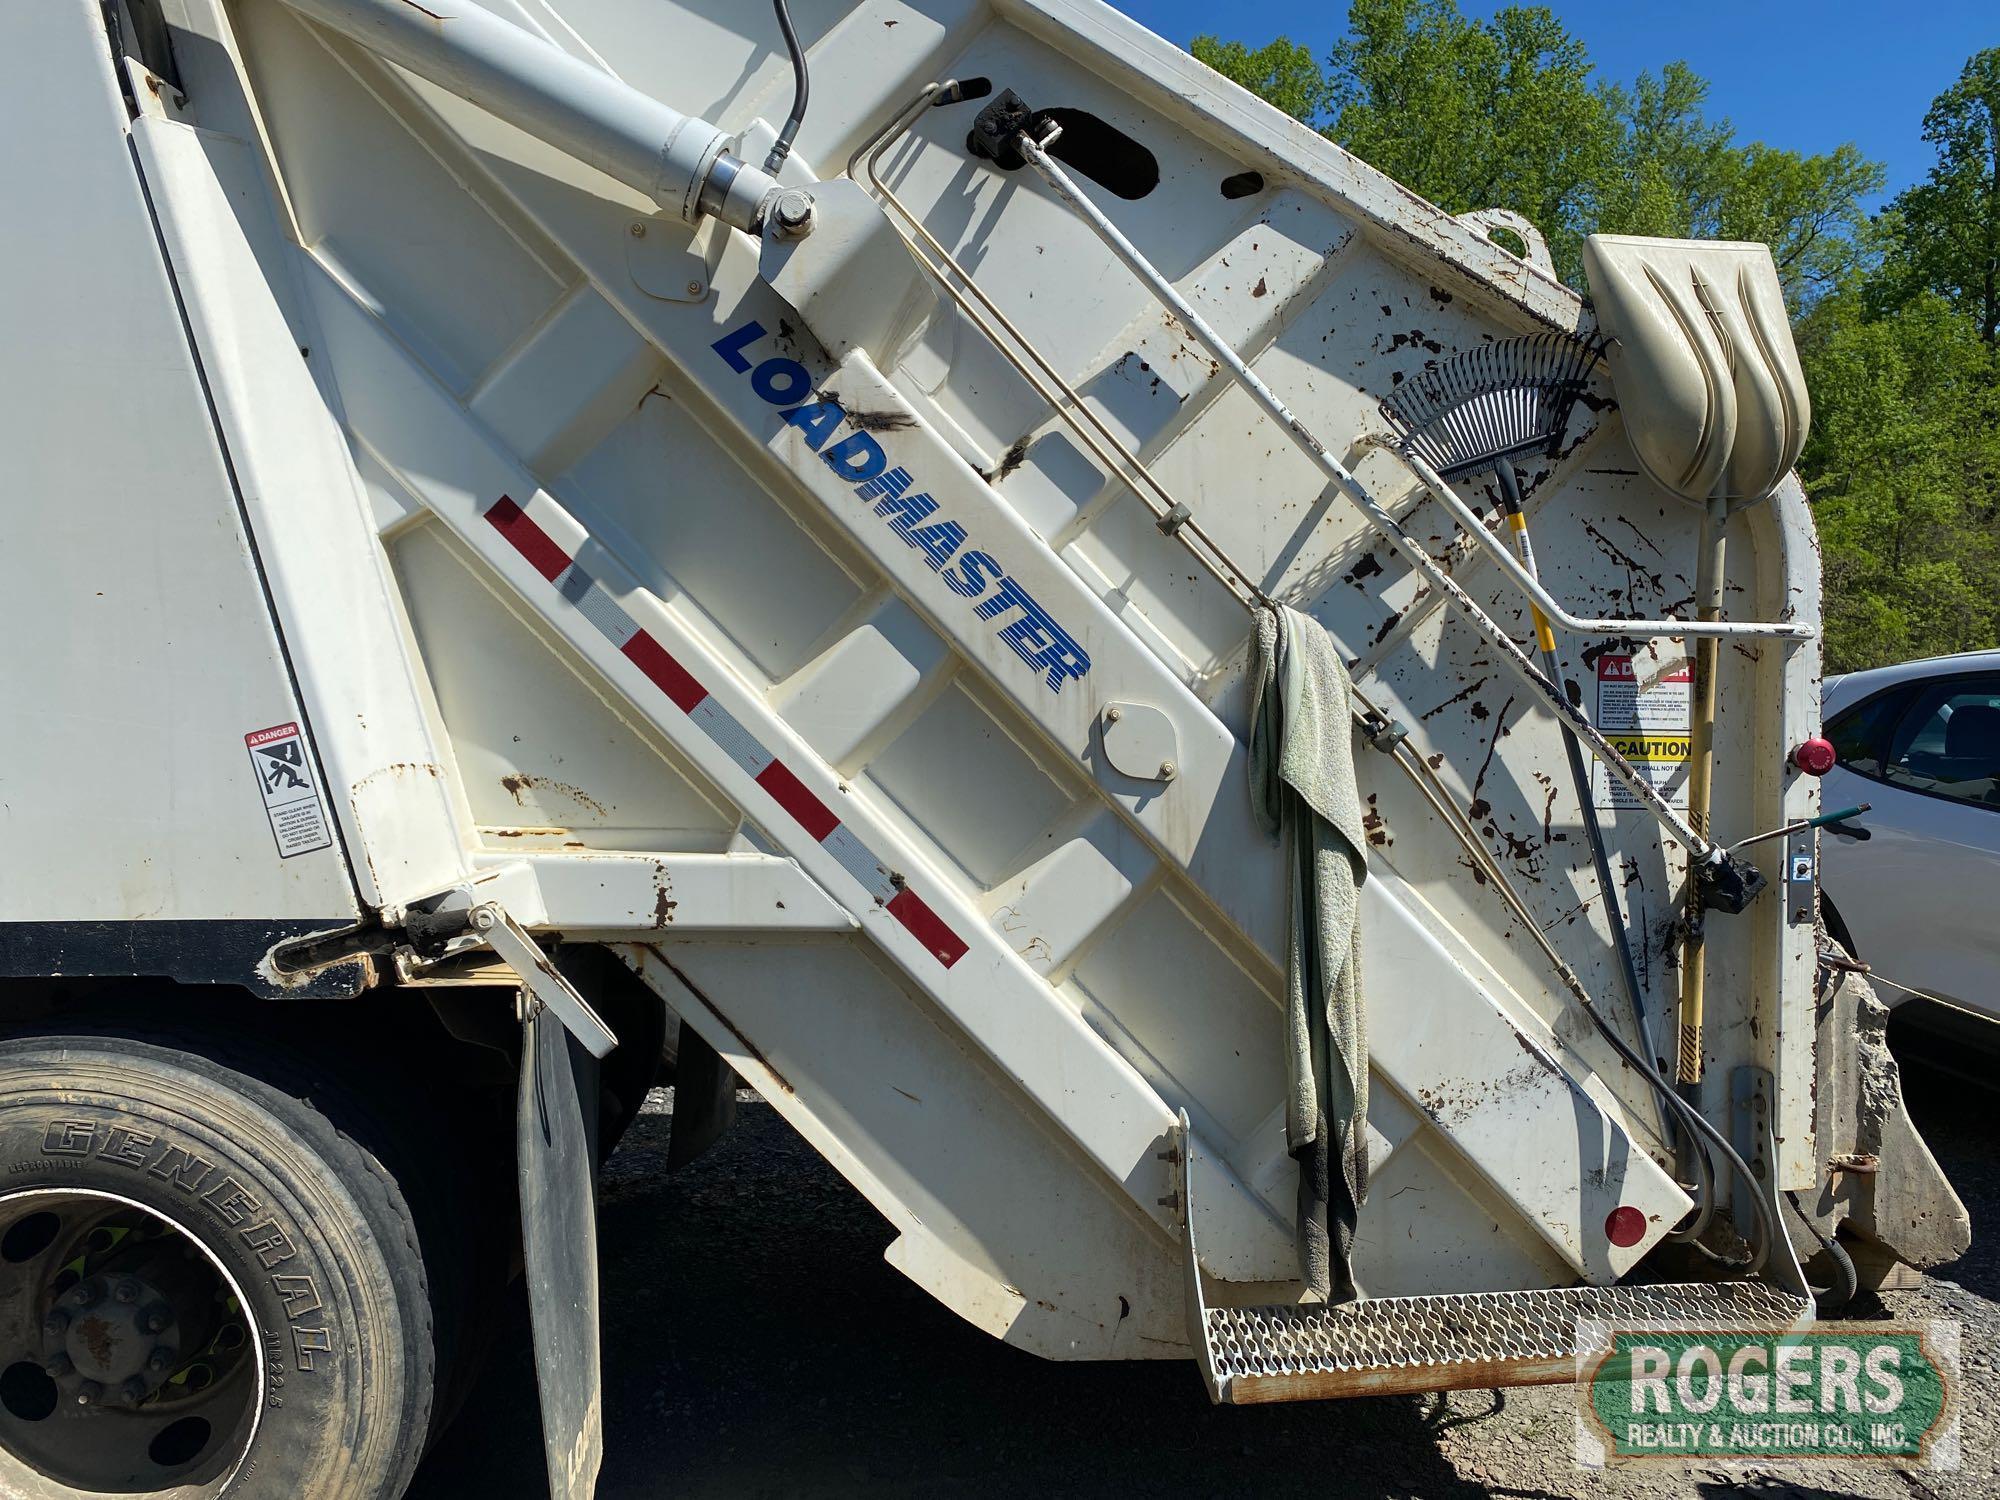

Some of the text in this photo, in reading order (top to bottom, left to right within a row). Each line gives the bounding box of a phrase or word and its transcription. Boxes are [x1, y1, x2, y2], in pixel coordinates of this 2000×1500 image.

[710, 320, 1091, 694] LOADMASTER
[258, 726, 296, 742] DANGER
[1615, 741, 1692, 756] CAUTION
[41, 1119, 331, 1371] GENERAL
